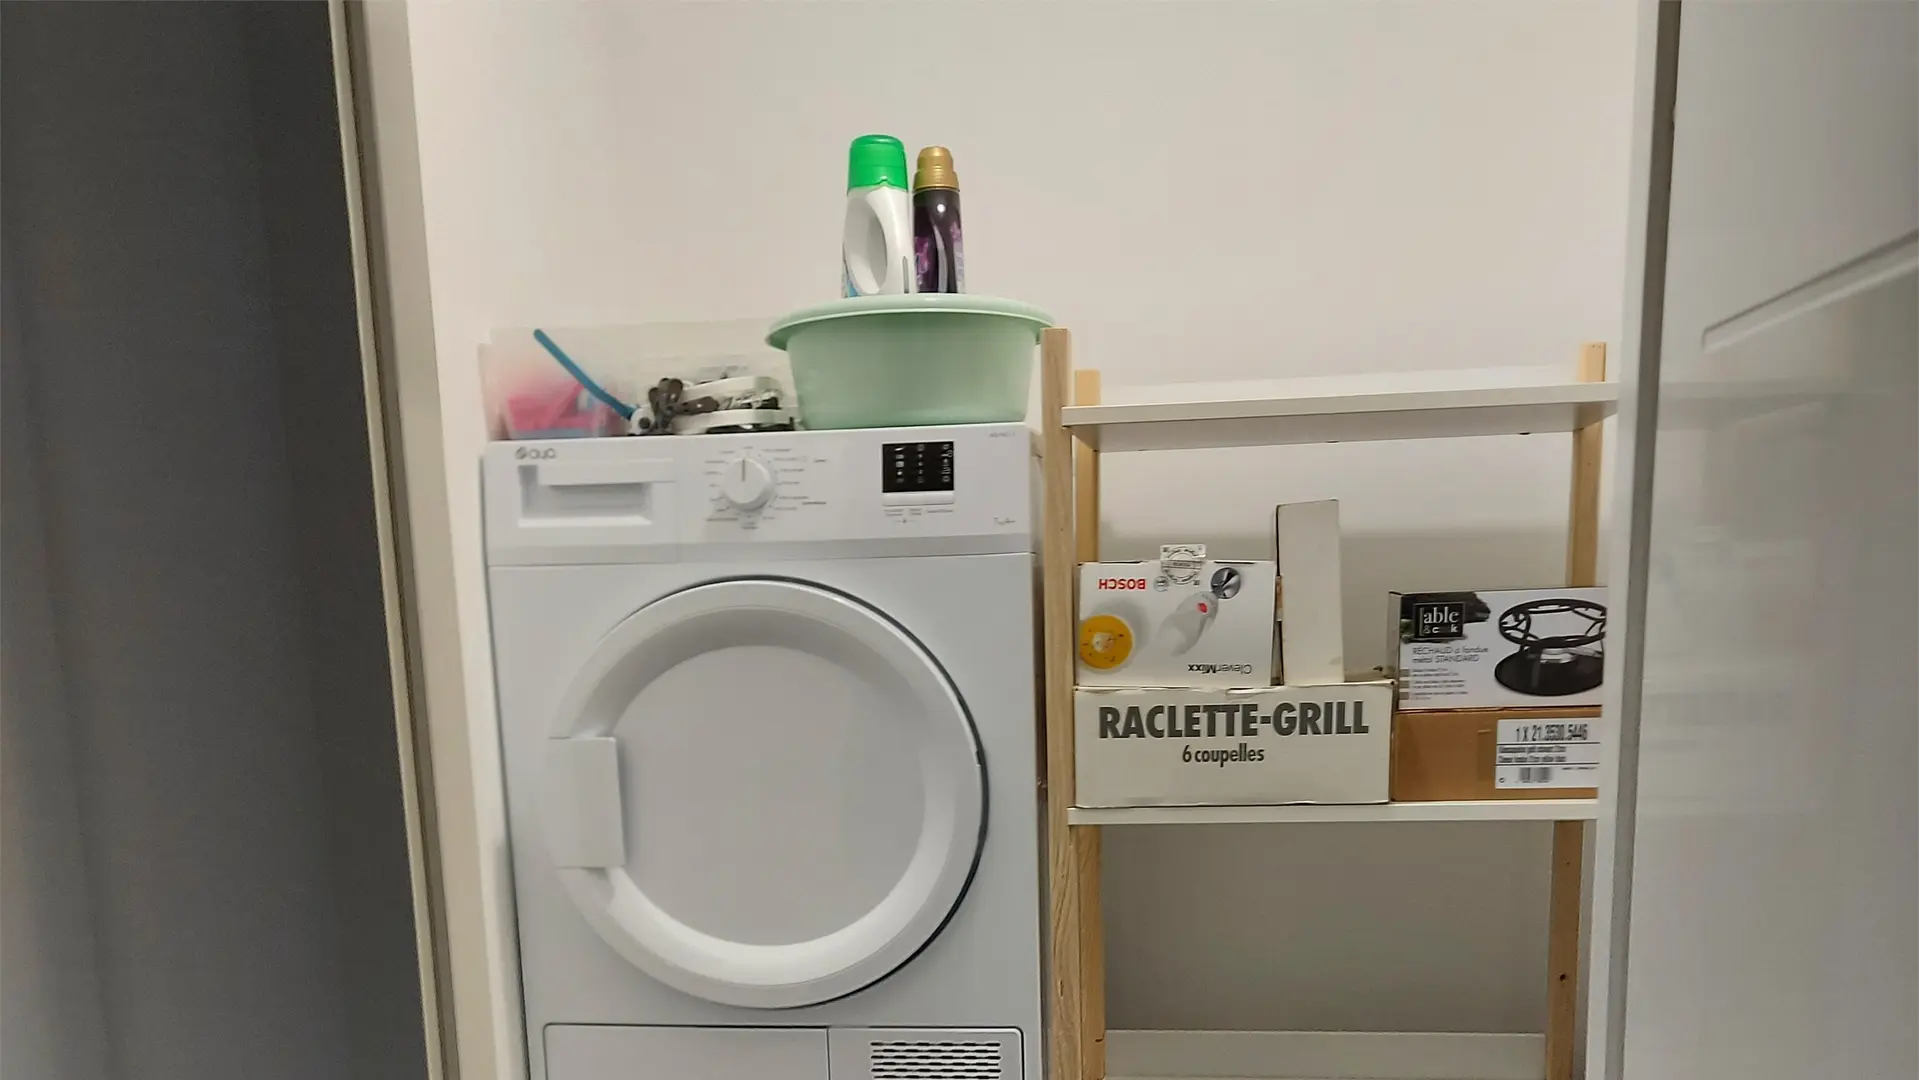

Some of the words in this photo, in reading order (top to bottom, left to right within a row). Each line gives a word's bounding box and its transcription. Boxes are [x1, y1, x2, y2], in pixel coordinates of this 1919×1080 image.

[1098, 578, 1147, 590] BOSCH
[1435, 654, 1480, 663] STANDARD
[1187, 663, 1253, 676] CleverMixx
[1098, 700, 1370, 739] RACLETTE-GRILL
[1515, 727, 1520, 742] 1
[1182, 744, 1191, 763] 6
[1194, 742, 1265, 768] coupelles
